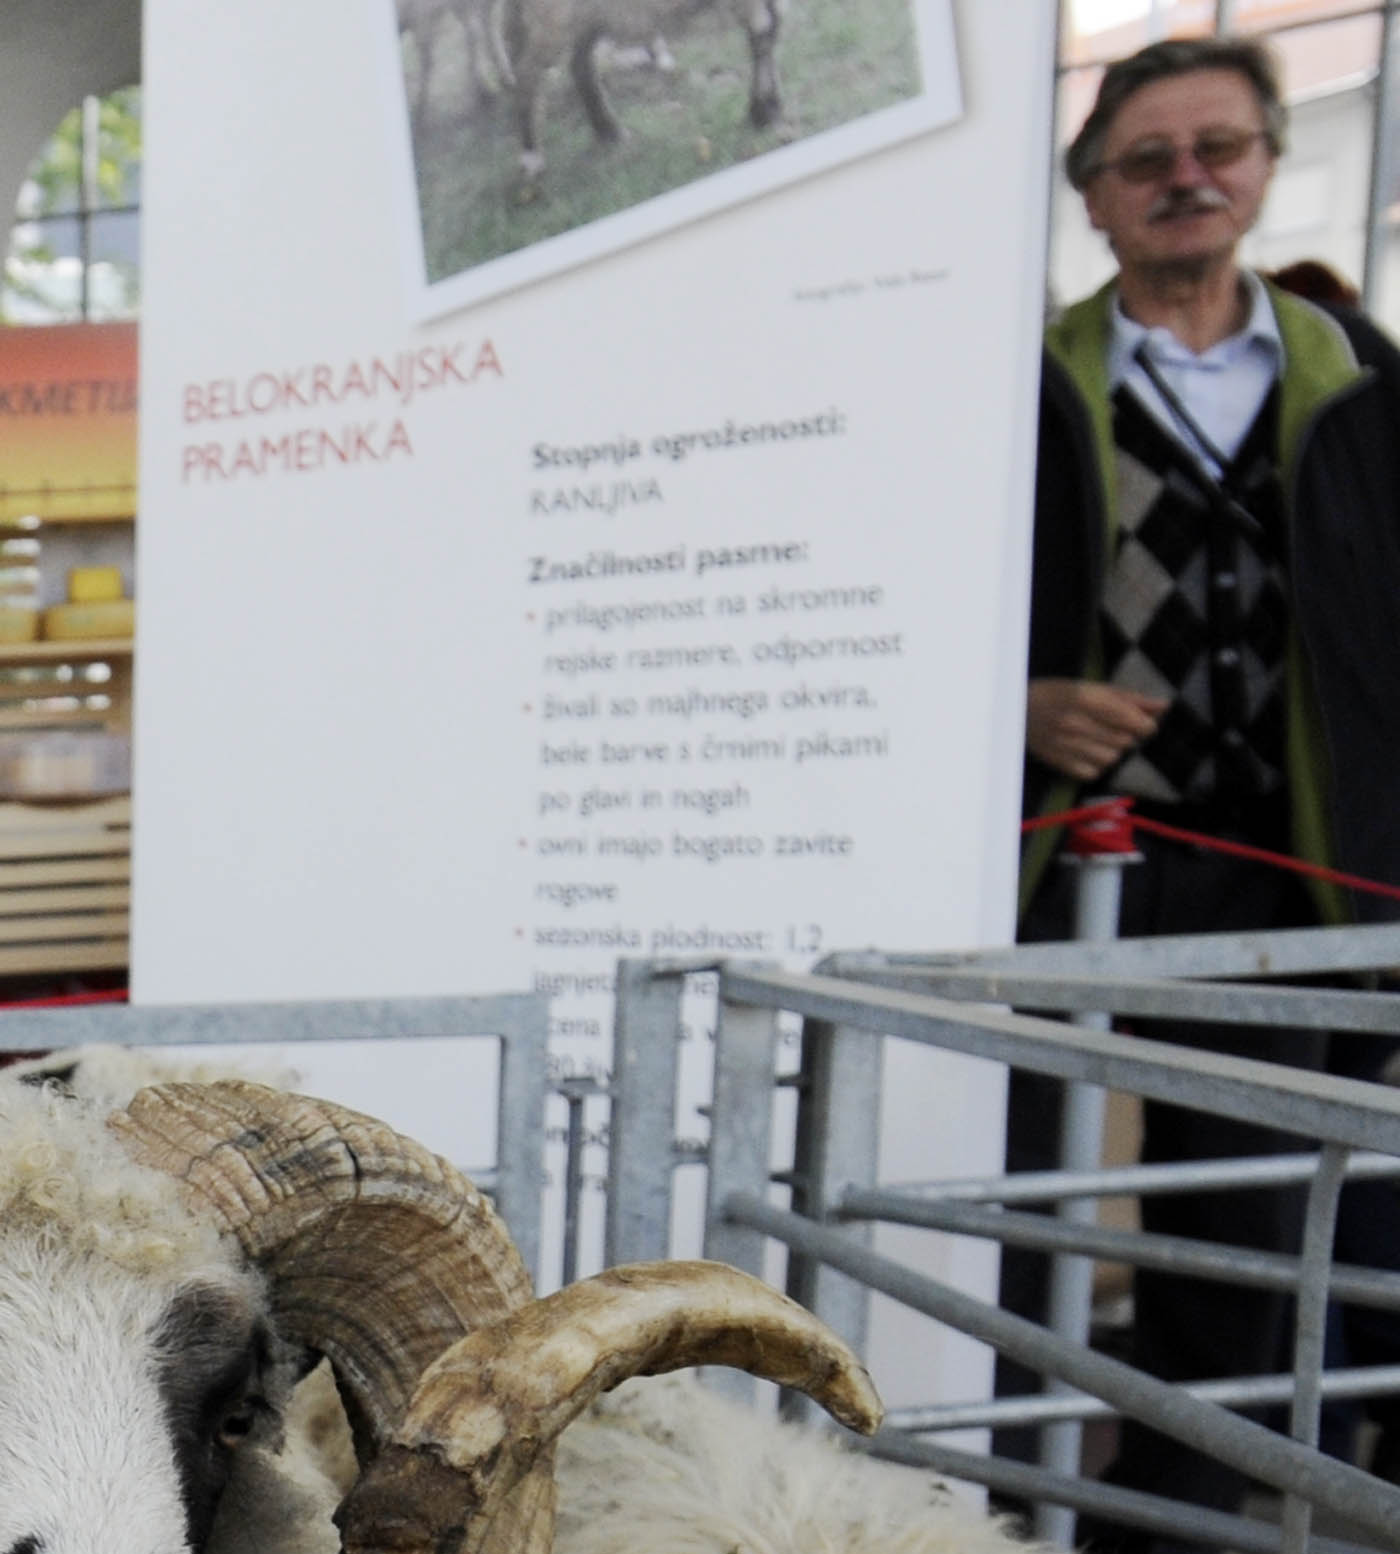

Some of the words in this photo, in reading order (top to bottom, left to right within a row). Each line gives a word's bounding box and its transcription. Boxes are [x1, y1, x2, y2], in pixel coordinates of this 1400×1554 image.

[183, 338, 504, 425] BELOKRANJSKA
[180, 417, 413, 485] PRAMENKA
[532, 433, 641, 470] Stopnja
[651, 404, 847, 462] ogroženosti:
[530, 476, 663, 515] RANLJIVA
[528, 543, 686, 583] Značilnosti
[695, 540, 810, 577] pasme:
[546, 596, 704, 633] prilagojenost
[716, 594, 747, 615] na
[758, 583, 884, 612] skromne
[752, 632, 902, 670] odpornost
[649, 687, 769, 720] majhnega
[794, 731, 889, 765] pikami
[538, 791, 571, 818] po
[672, 779, 751, 817] nogah
[538, 833, 586, 856] ovni
[598, 833, 664, 863] imajo
[672, 829, 764, 865] bogato
[773, 833, 854, 857] zavite
[535, 882, 620, 909] rogove
[534, 924, 643, 949] sezonska
